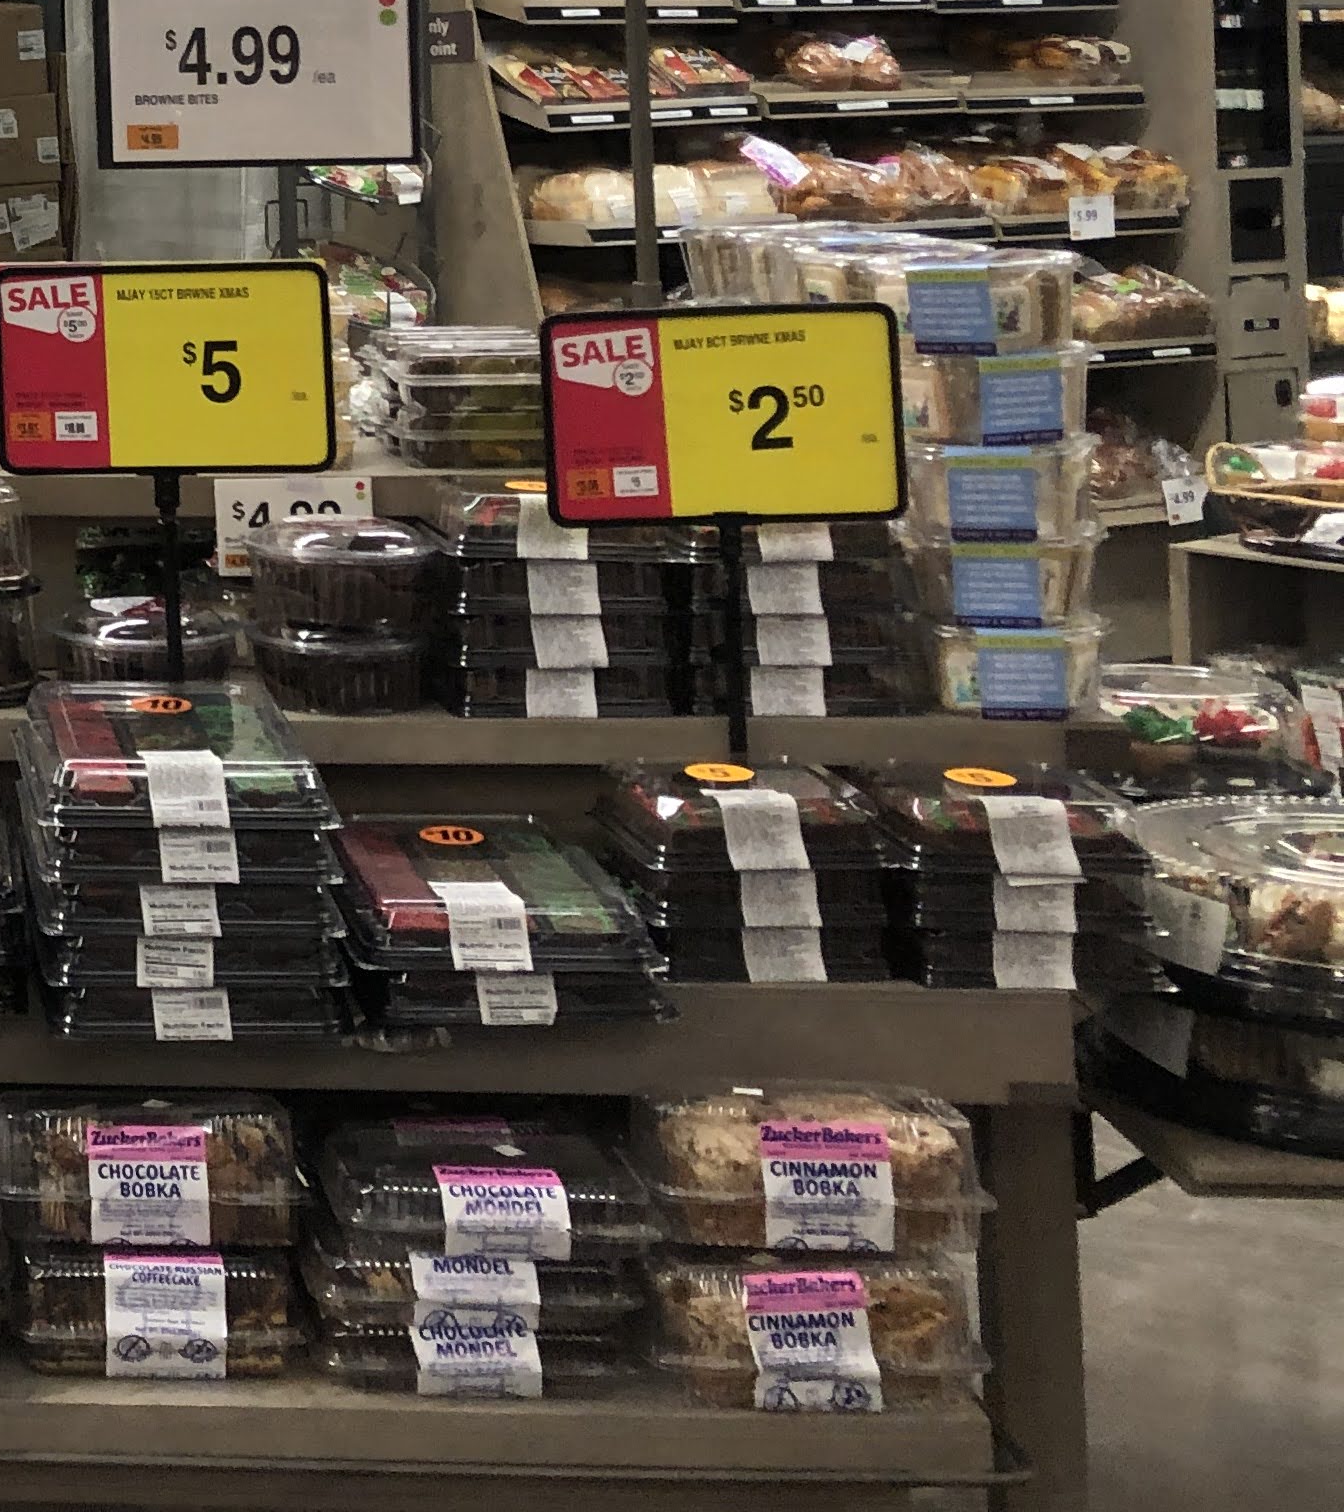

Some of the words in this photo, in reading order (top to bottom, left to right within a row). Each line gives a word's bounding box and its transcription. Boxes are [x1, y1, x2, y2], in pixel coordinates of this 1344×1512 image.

[428, 17, 450, 37] nly
[165, 24, 301, 86] $4.99
[429, 40, 458, 57] oint
[134, 94, 185, 106] BROWNIE
[187, 93, 219, 105] BITES
[7, 283, 91, 312] SALE
[561, 334, 647, 368] SALE
[182, 340, 242, 404] $5
[97, 1163, 201, 1181] CHOCOLATE
[770, 1161, 878, 1179] CINNAMON
[119, 1181, 182, 1199] BOBKA
[448, 1184, 558, 1200] CHOCOLATE
[793, 1180, 861, 1197] BOBKA
[465, 1199, 544, 1216] MONDEL
[432, 1259, 515, 1276] MONDEL
[748, 1312, 855, 1332] CINNAMON
[770, 1332, 838, 1350] BOBKA
[435, 1342, 519, 1359] MONDEL
